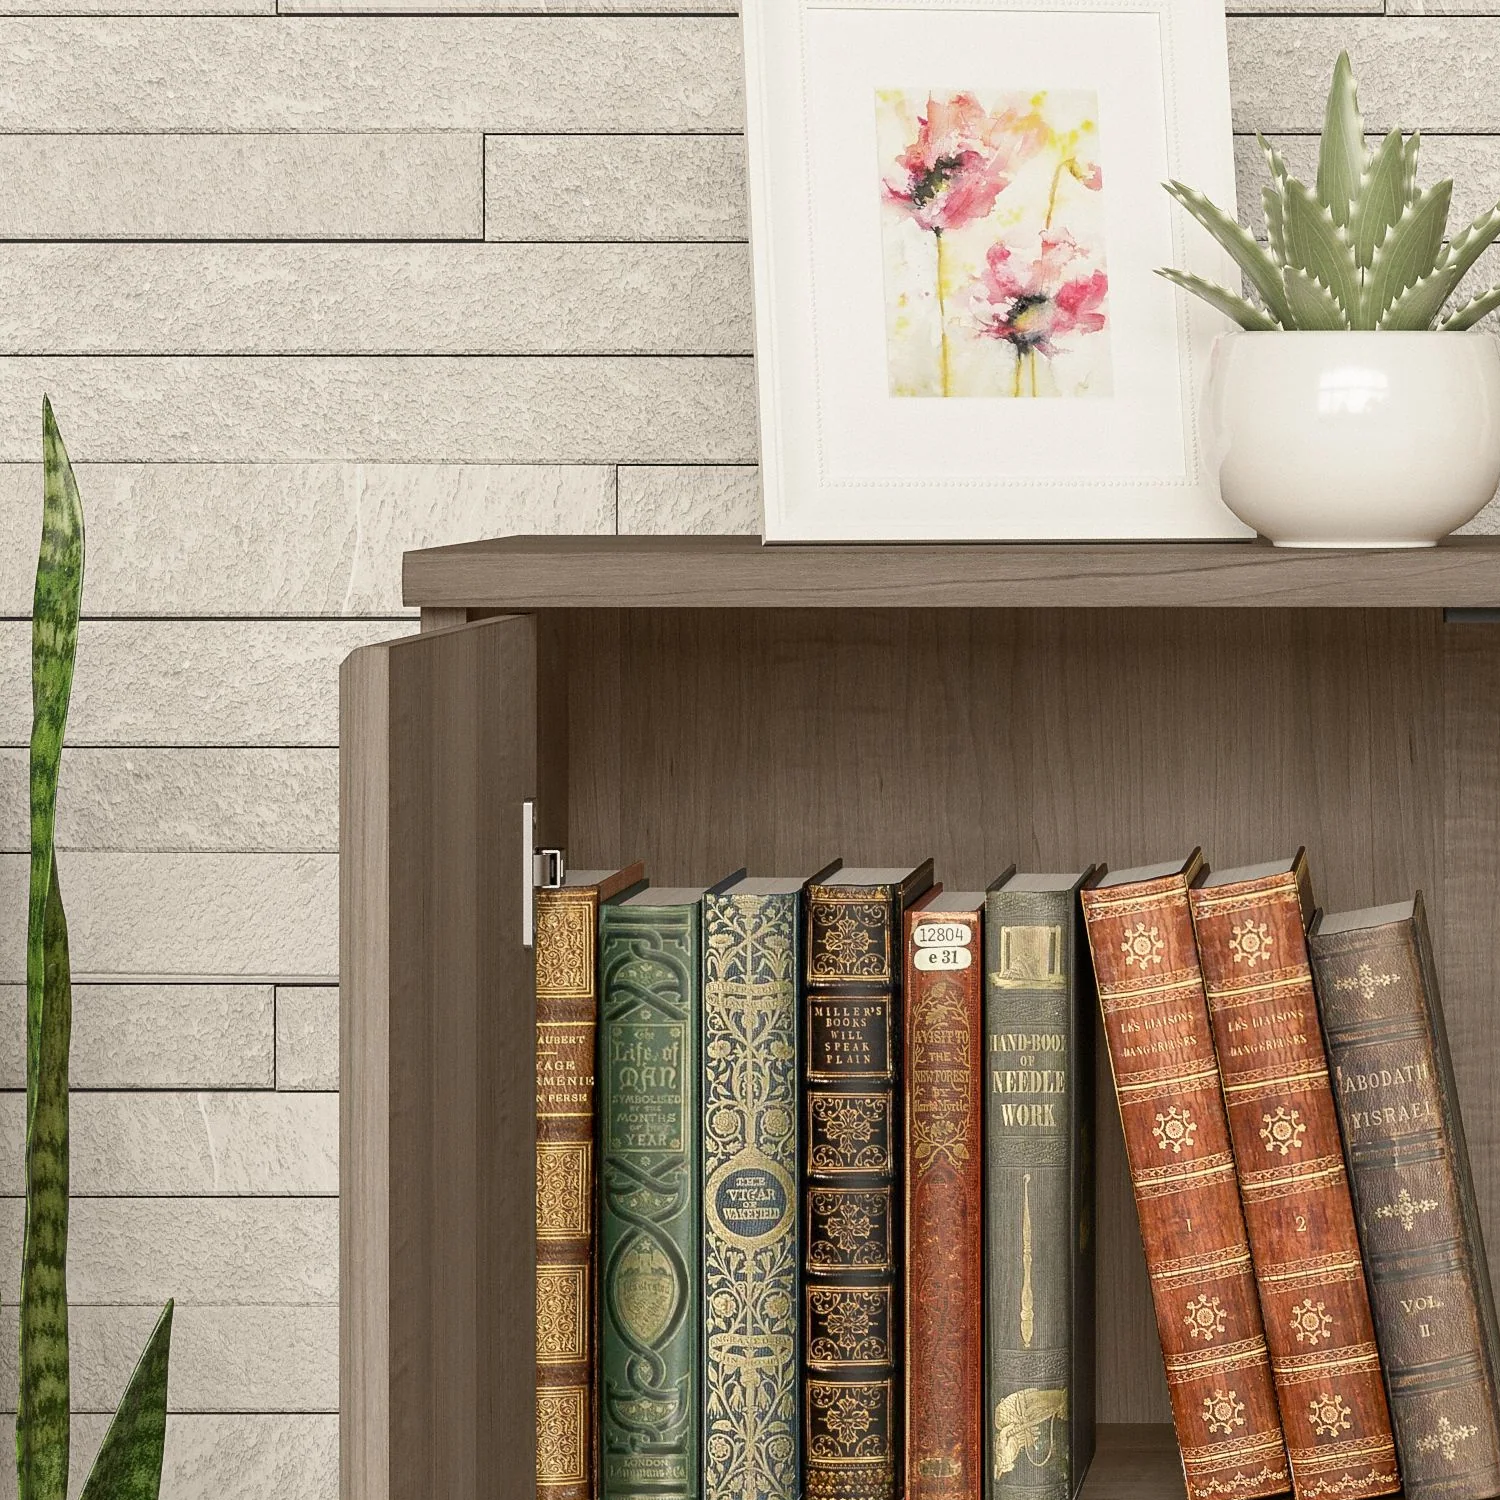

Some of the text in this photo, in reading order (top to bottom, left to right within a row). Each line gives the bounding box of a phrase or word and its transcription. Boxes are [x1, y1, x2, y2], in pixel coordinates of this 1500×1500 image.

[920, 928, 963, 942] 12804
[929, 950, 958, 964] e 31
[814, 1006, 882, 1017] MILLER'S
[826, 1017, 867, 1028] BOOKS
[1145, 1011, 1194, 1030] LIAISONS
[1252, 1009, 1304, 1029] LIAISONS
[830, 1030, 863, 1040] WILL
[955, 1030, 969, 1044] TO
[824, 1042, 870, 1052] SPEAK
[661, 1041, 680, 1067] of
[826, 1054, 871, 1064] PLAIN
[928, 1052, 951, 1062] THE
[1020, 1055, 1035, 1067] OF
[914, 1069, 970, 1083] NEW FOREST
[992, 1070, 1066, 1094] NEEDLE
[617, 1112, 676, 1123] MONTHS
[1001, 1103, 1057, 1127] WORK
[1351, 1101, 1436, 1129] YISRAEL
[625, 1134, 667, 1146] YEAR
[736, 1177, 766, 1186] THE
[726, 1188, 776, 1201] VICAR
[722, 1208, 780, 1220] WAKEFIELD
[1295, 1216, 1307, 1231] 2
[1400, 1295, 1444, 1313] VOL.
[624, 1459, 669, 1468] LONDON
